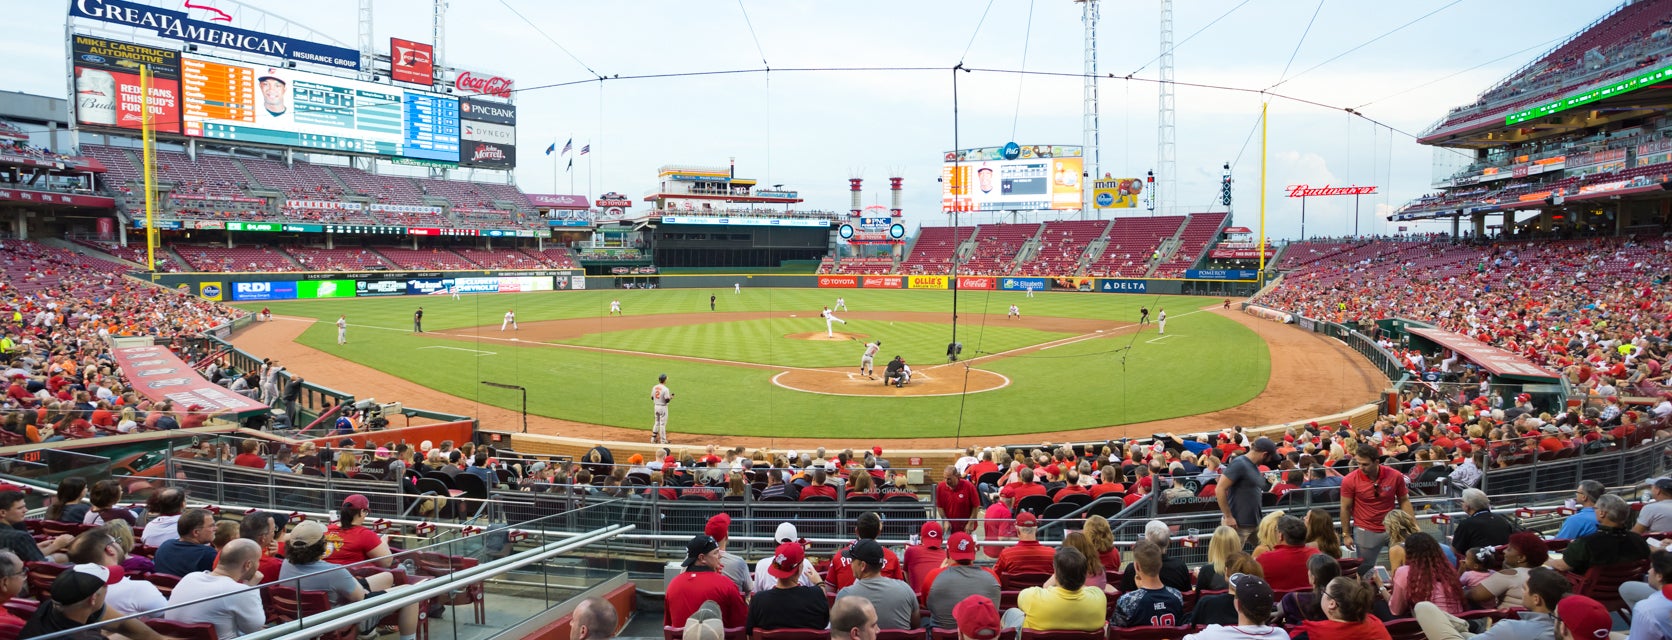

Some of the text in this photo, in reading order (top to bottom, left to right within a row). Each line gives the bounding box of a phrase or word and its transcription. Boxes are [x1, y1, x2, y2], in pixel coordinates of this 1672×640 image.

[76, 0, 357, 68] GREAT AMERICAN INSURANCE GROUP
[76, 37, 175, 59] MIKE CASTRUCCI
[89, 46, 164, 64] AUTOMOTIVE
[455, 71, 513, 99] Coca-Cola
[147, 87, 175, 100] FANS,
[121, 102, 141, 112] FOR
[146, 96, 174, 108] BUD'S
[471, 104, 515, 118] PNC BANK
[476, 128, 511, 138] DYNEGY
[471, 149, 506, 161] Morrell
[1286, 183, 1377, 198] Budweiser
[238, 281, 271, 293] RDI
[914, 277, 942, 286] OLLIE'S
[963, 278, 988, 288] Coca-Cola
[1020, 280, 1043, 288] Elizabeth
[1113, 282, 1145, 290] DELTA
[655, 390, 661, 400] 2
[24, 450, 41, 462] EXIT
[1153, 601, 1167, 611] HEIL
